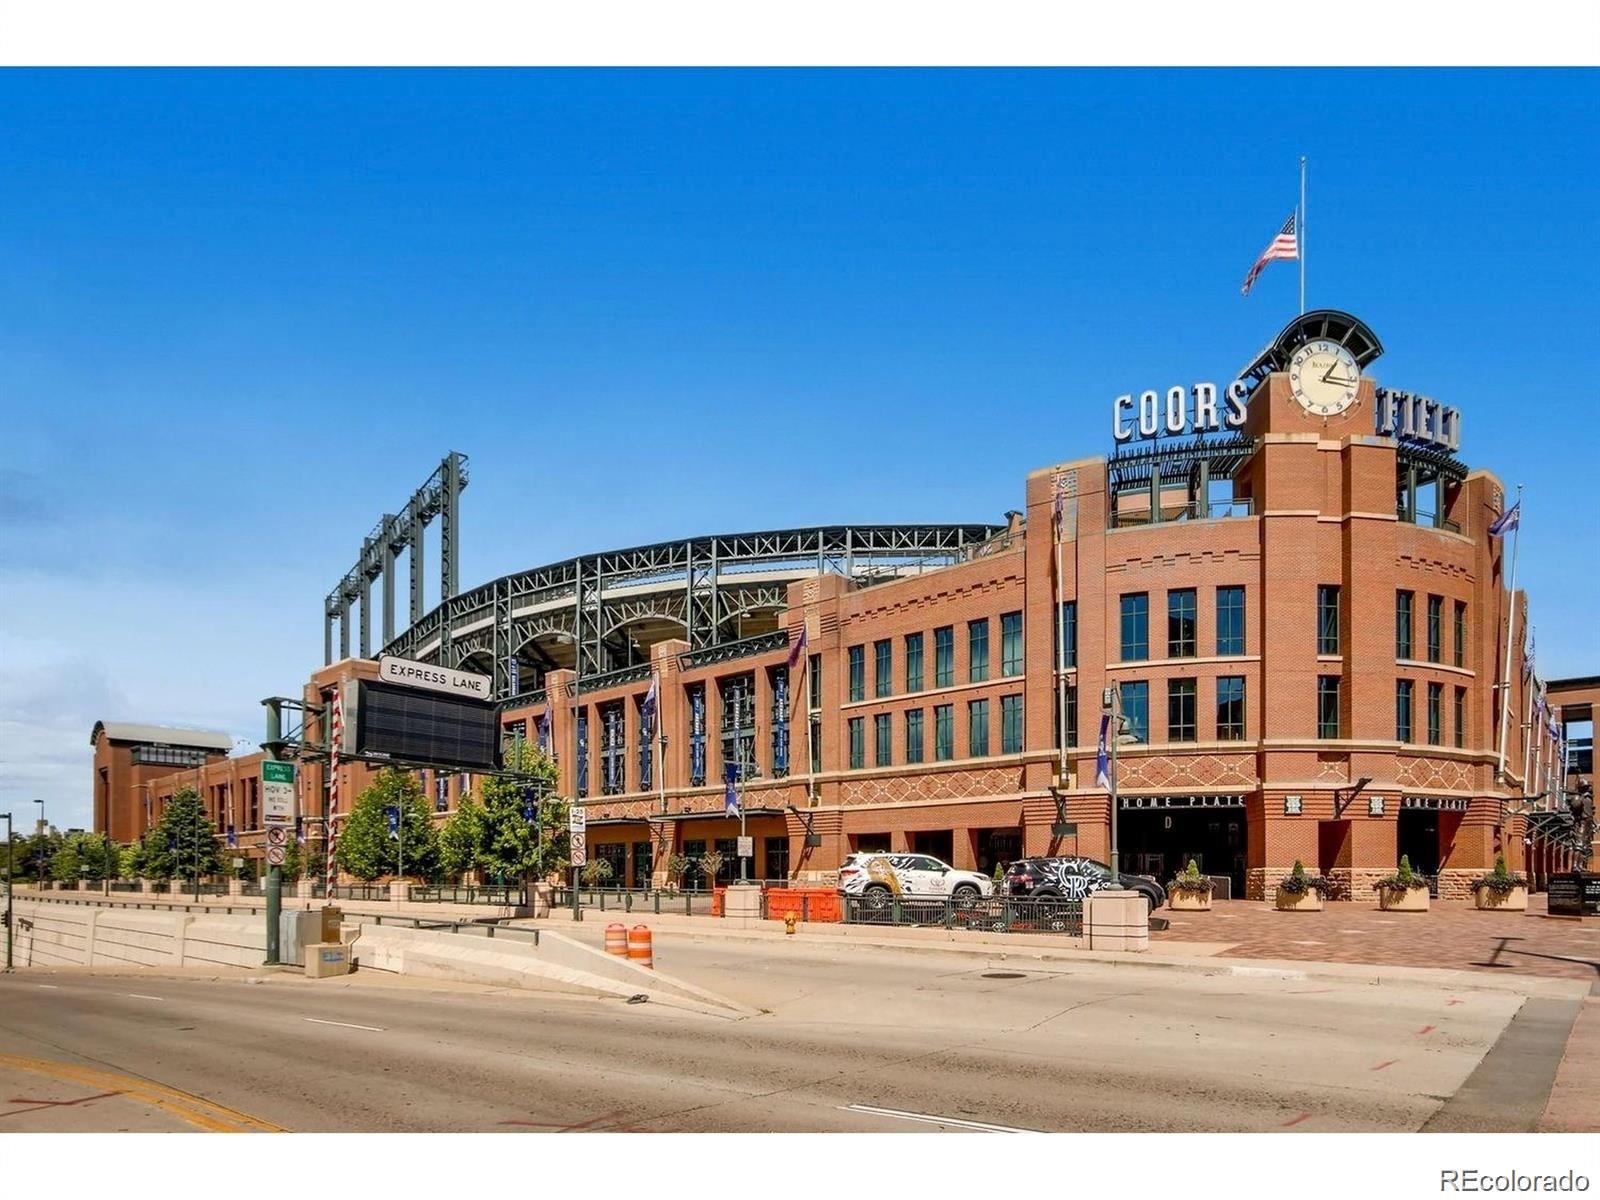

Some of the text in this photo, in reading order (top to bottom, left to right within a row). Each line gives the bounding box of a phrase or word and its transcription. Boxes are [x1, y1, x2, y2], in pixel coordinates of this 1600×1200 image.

[1319, 343, 1329, 352] 12
[1112, 380, 1247, 440] COORS
[1381, 388, 1461, 450] FIELD
[390, 664, 482, 692] EXPRESS LANE
[1123, 795, 1245, 808] HOME PLATE
[1437, 798, 1468, 810] PLATE
